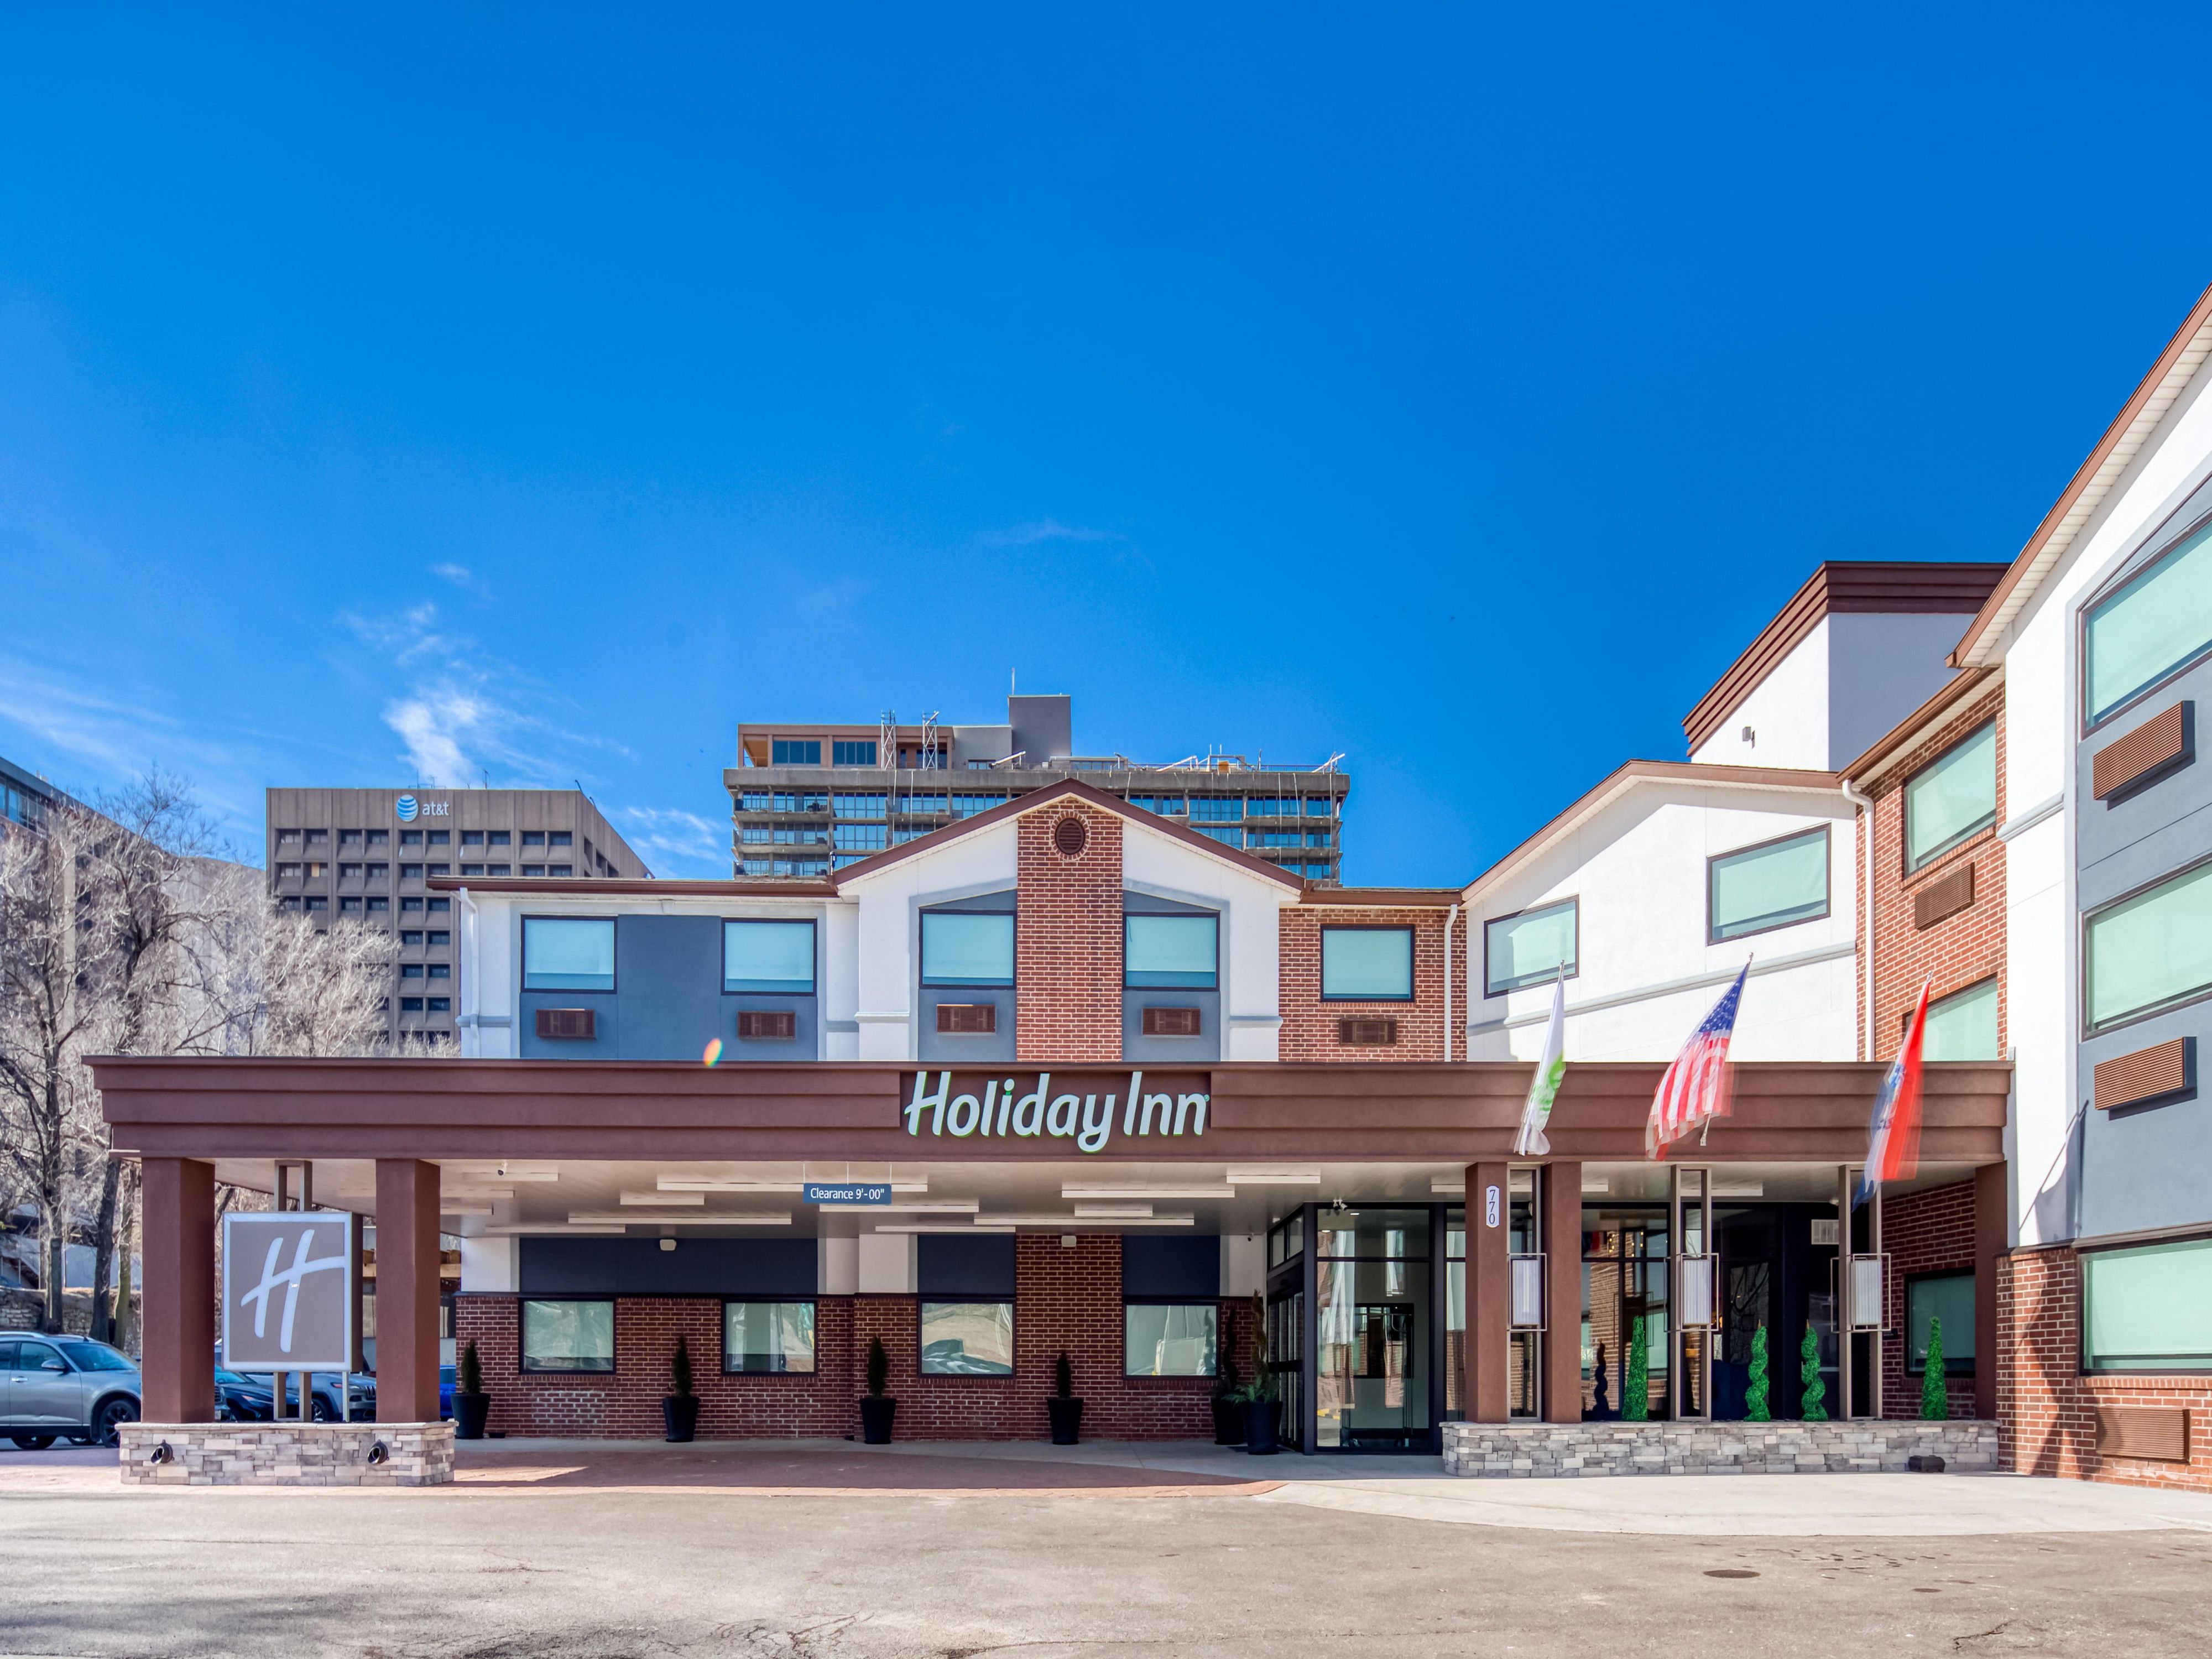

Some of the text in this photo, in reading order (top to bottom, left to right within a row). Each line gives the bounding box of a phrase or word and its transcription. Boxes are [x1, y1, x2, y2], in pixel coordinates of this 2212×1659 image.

[422, 801, 449, 816] at&t
[904, 1071, 1116, 1153] Holiday
[810, 1187, 853, 1199] Clearance
[241, 1229, 345, 1353] H
